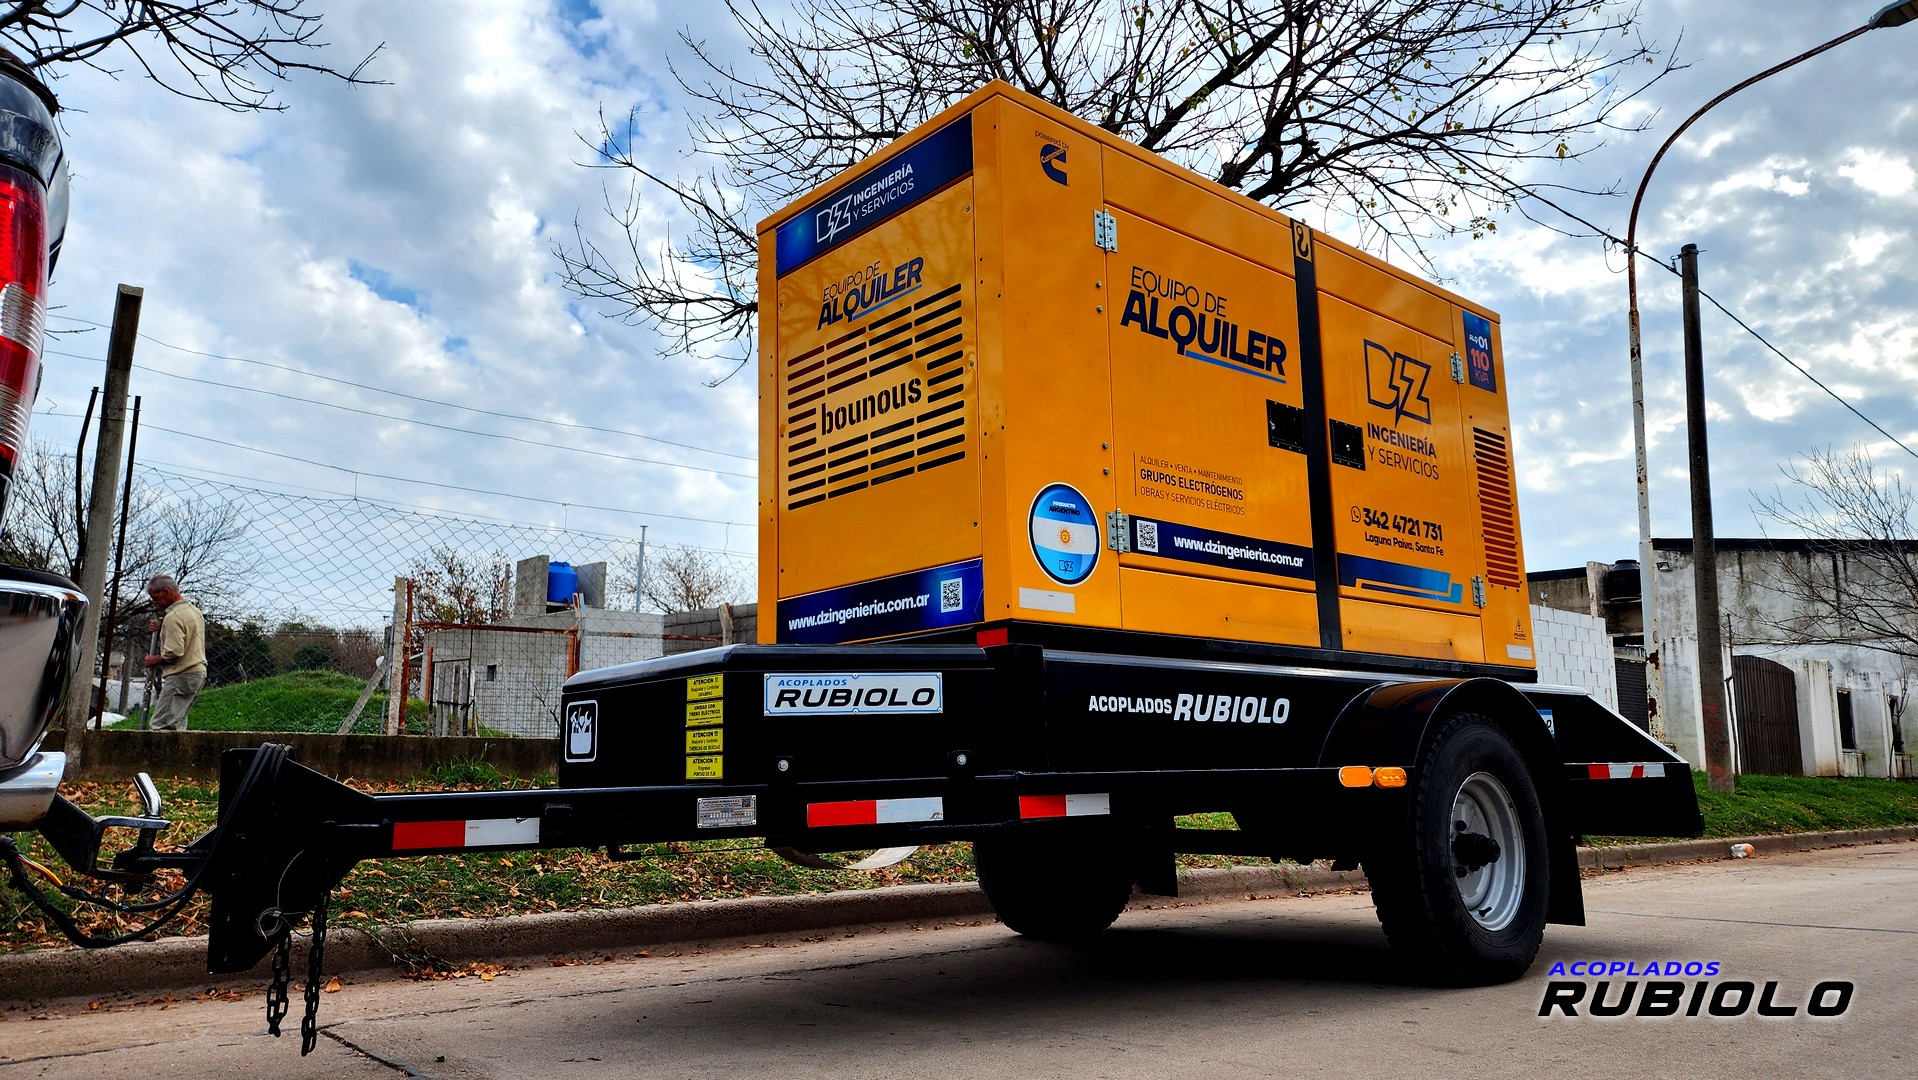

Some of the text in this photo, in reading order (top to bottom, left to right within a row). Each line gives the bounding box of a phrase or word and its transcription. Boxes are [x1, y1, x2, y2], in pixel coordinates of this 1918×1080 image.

[1062, 140, 1070, 151] by
[852, 178, 915, 221] Y SERVICIOS
[853, 163, 914, 206] INGENIERÍA
[816, 256, 924, 331] ALQUILER
[823, 261, 881, 302] EQUIPO DE
[1131, 265, 1228, 318] EQUIPO DE
[1120, 289, 1287, 376] ALQUILER
[1478, 335, 1489, 350] 01
[1470, 348, 1490, 371] 110
[821, 377, 922, 436] bounous
[1366, 421, 1438, 459] INGENIERÍA
[1139, 455, 1243, 486] ALQUILER VENTA MANTENIMIENTO
[1367, 444, 1440, 480] Y SERVICIOS
[1140, 468, 1244, 501] GRUPOS ELECTRÓGENOS
[1140, 486, 1245, 516] OBRAS Y SERVICIOS ELÉCTRICOS
[1048, 506, 1081, 516] ARGENTINO
[1052, 500, 1076, 509] PRODUCTO
[1362, 507, 1443, 541] 342 4721 731
[1173, 535, 1304, 568] www.dzingenieria.com.ar
[1364, 531, 1444, 556] Laguna Paiva, Santa Fe
[788, 592, 930, 631] www.dzingenieria.com.ar
[774, 687, 935, 708] RUBIOLO
[777, 679, 848, 687] ACOPLADOS
[1088, 693, 1290, 724] ACOPLADOS RUBIOLO
